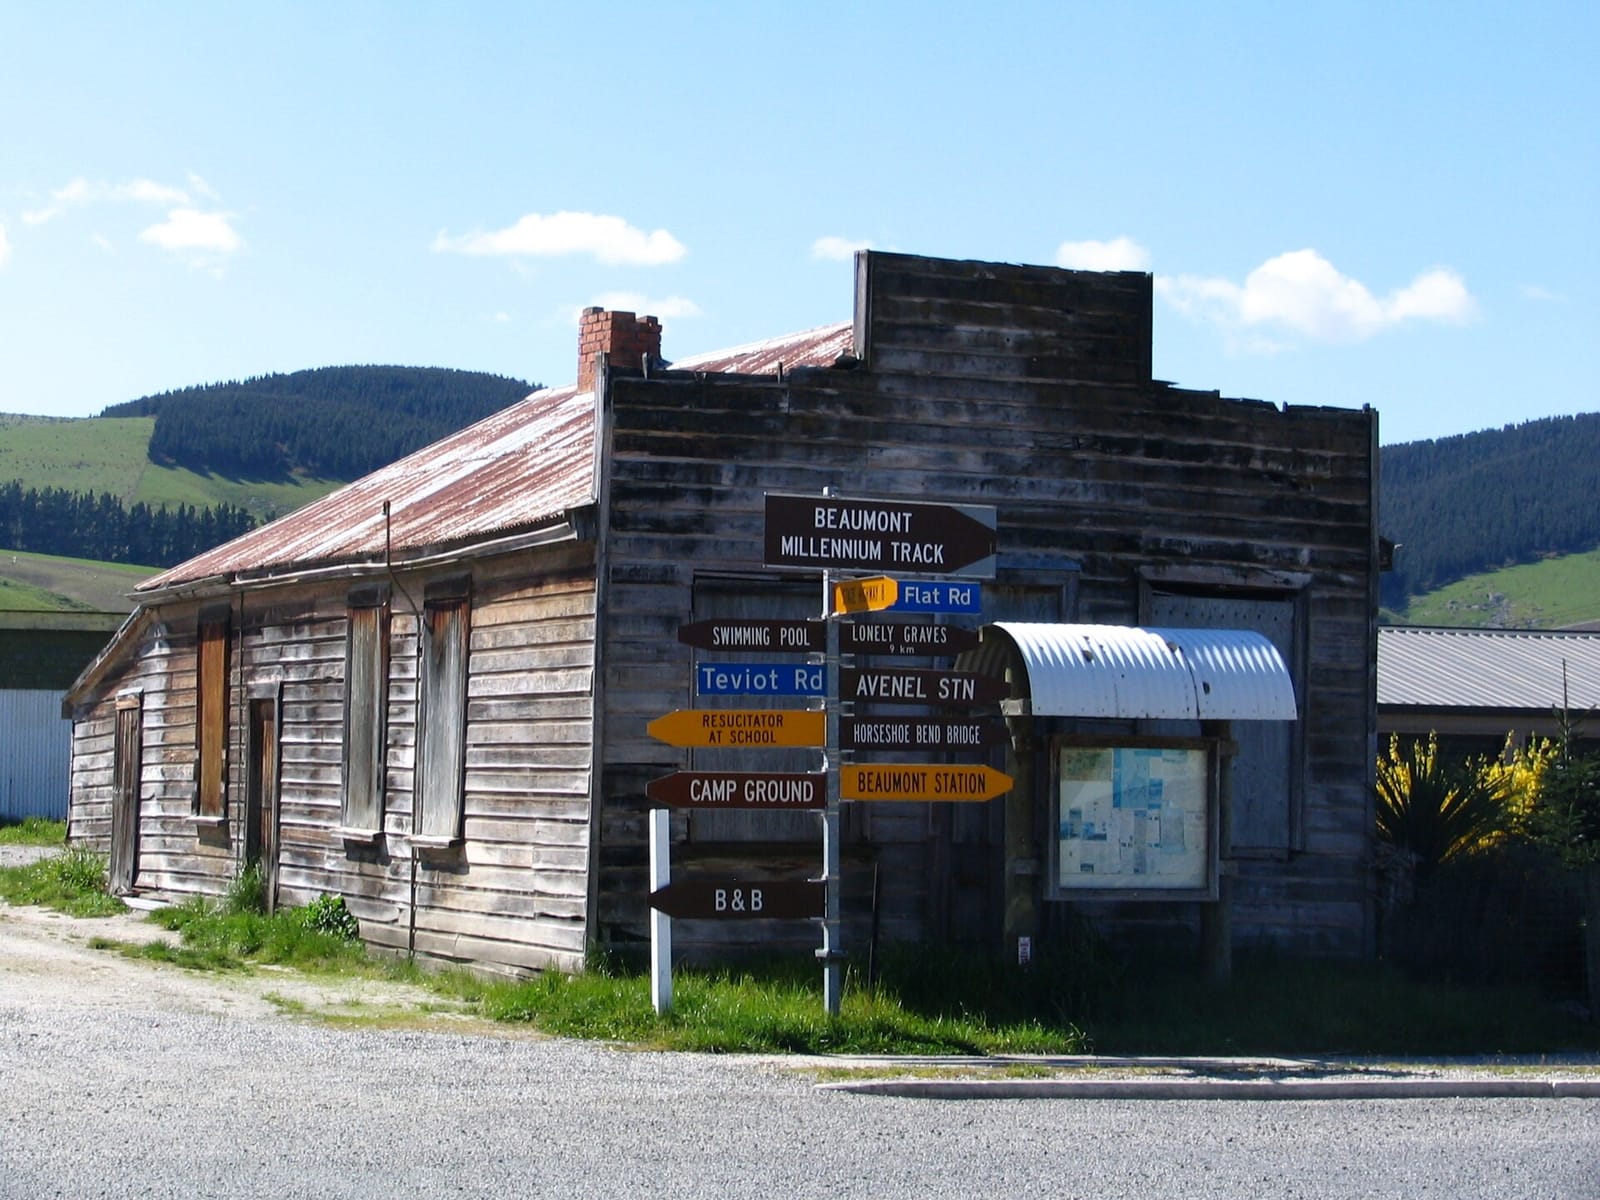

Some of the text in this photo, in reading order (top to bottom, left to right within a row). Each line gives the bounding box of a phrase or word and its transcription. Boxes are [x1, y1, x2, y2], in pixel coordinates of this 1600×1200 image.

[814, 507, 912, 533] BEAUMONT
[781, 535, 944, 564] MILLENNIUM TRACK
[905, 586, 940, 606] Flat
[948, 587, 971, 606] Rd
[712, 626, 810, 646] SWIMMING POOL
[852, 625, 947, 644] LONELY GRAVES
[889, 644, 915, 654] 9 km
[702, 668, 823, 690] Teviot Rd
[856, 675, 975, 700] AVENEL STN
[702, 714, 784, 728] RESUCITATOR
[709, 730, 777, 743] AT SCHOOL
[853, 723, 981, 745] HORSESHOE BEND BRIDGE
[690, 779, 814, 802] CAMP GROUND
[858, 772, 986, 794] BEAUMONT STATION
